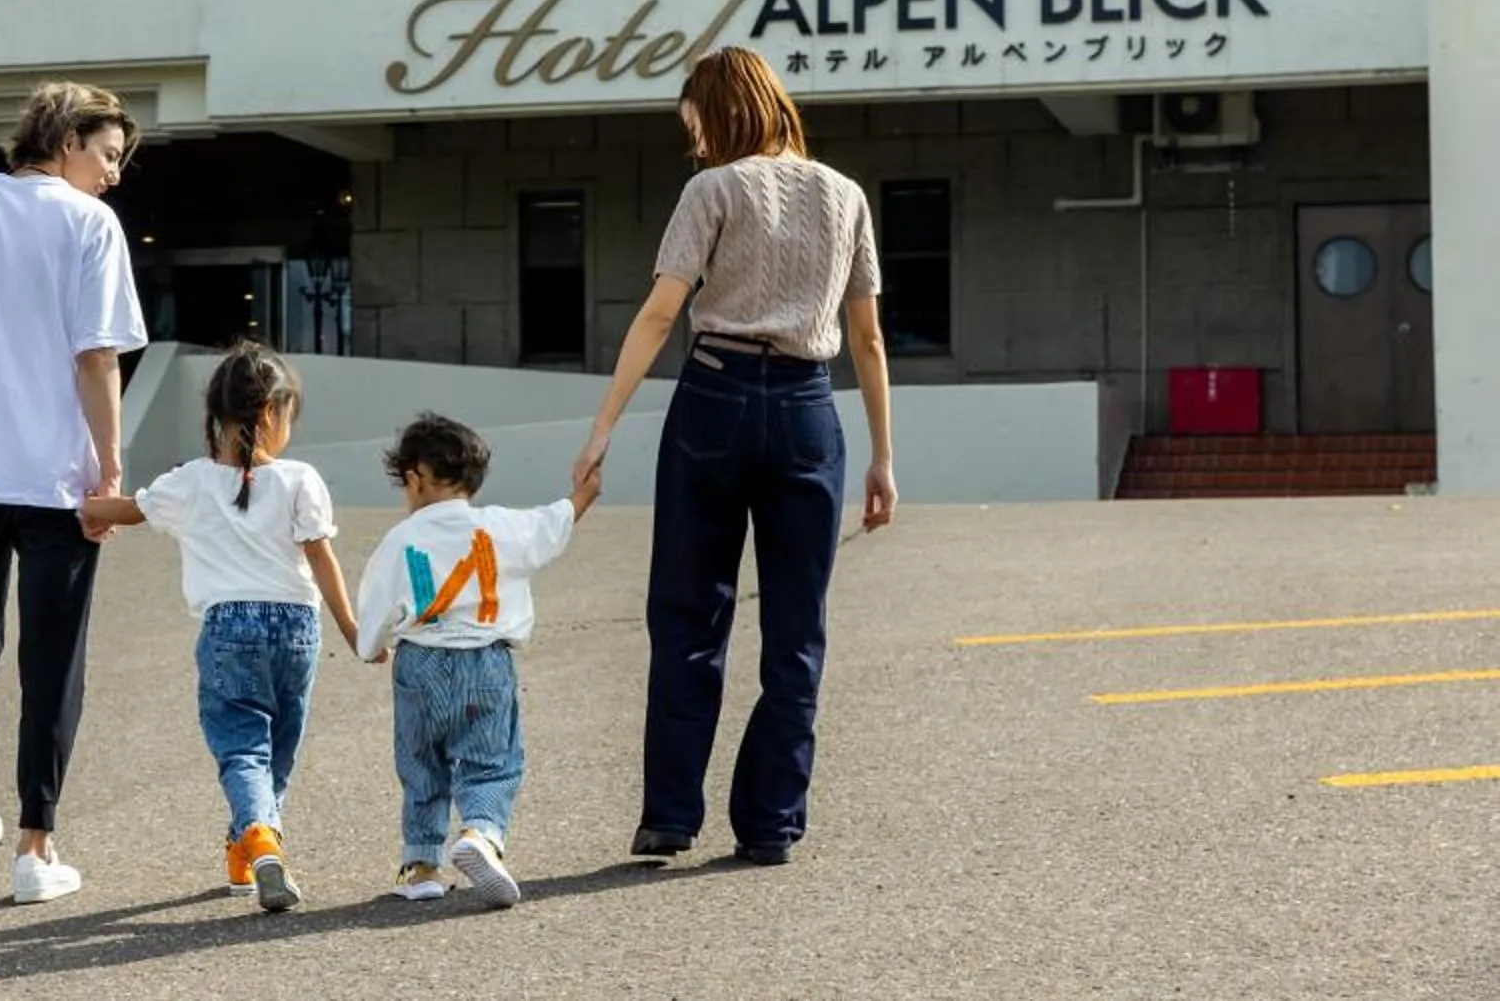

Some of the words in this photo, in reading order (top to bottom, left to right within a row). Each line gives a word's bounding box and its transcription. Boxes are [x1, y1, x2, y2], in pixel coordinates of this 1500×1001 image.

[787, 48, 888, 73] ホテル
[923, 33, 1227, 69] アルペンブリック
